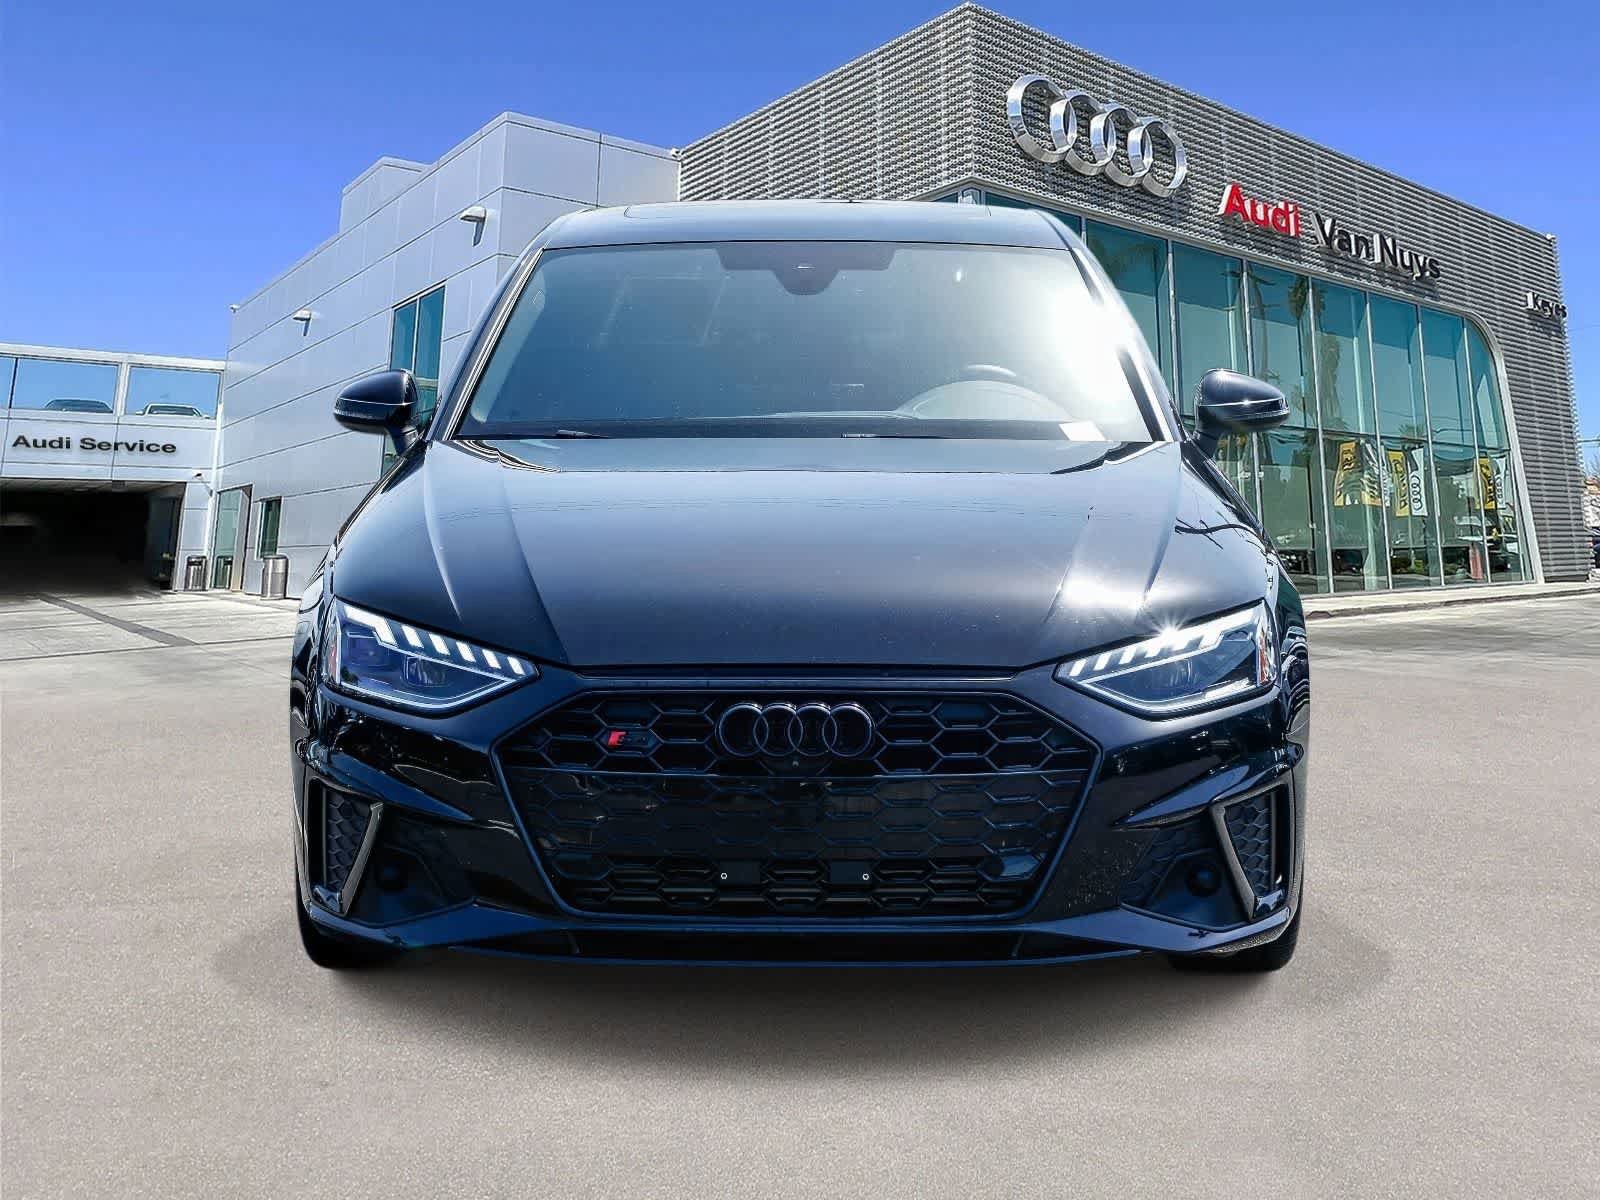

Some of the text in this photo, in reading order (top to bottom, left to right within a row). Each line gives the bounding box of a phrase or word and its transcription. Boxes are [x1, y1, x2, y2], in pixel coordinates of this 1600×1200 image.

[1217, 182, 1441, 280] Audi Van Nuys
[1526, 291, 1568, 319] Keyes
[12, 435, 177, 453] Audi Service
